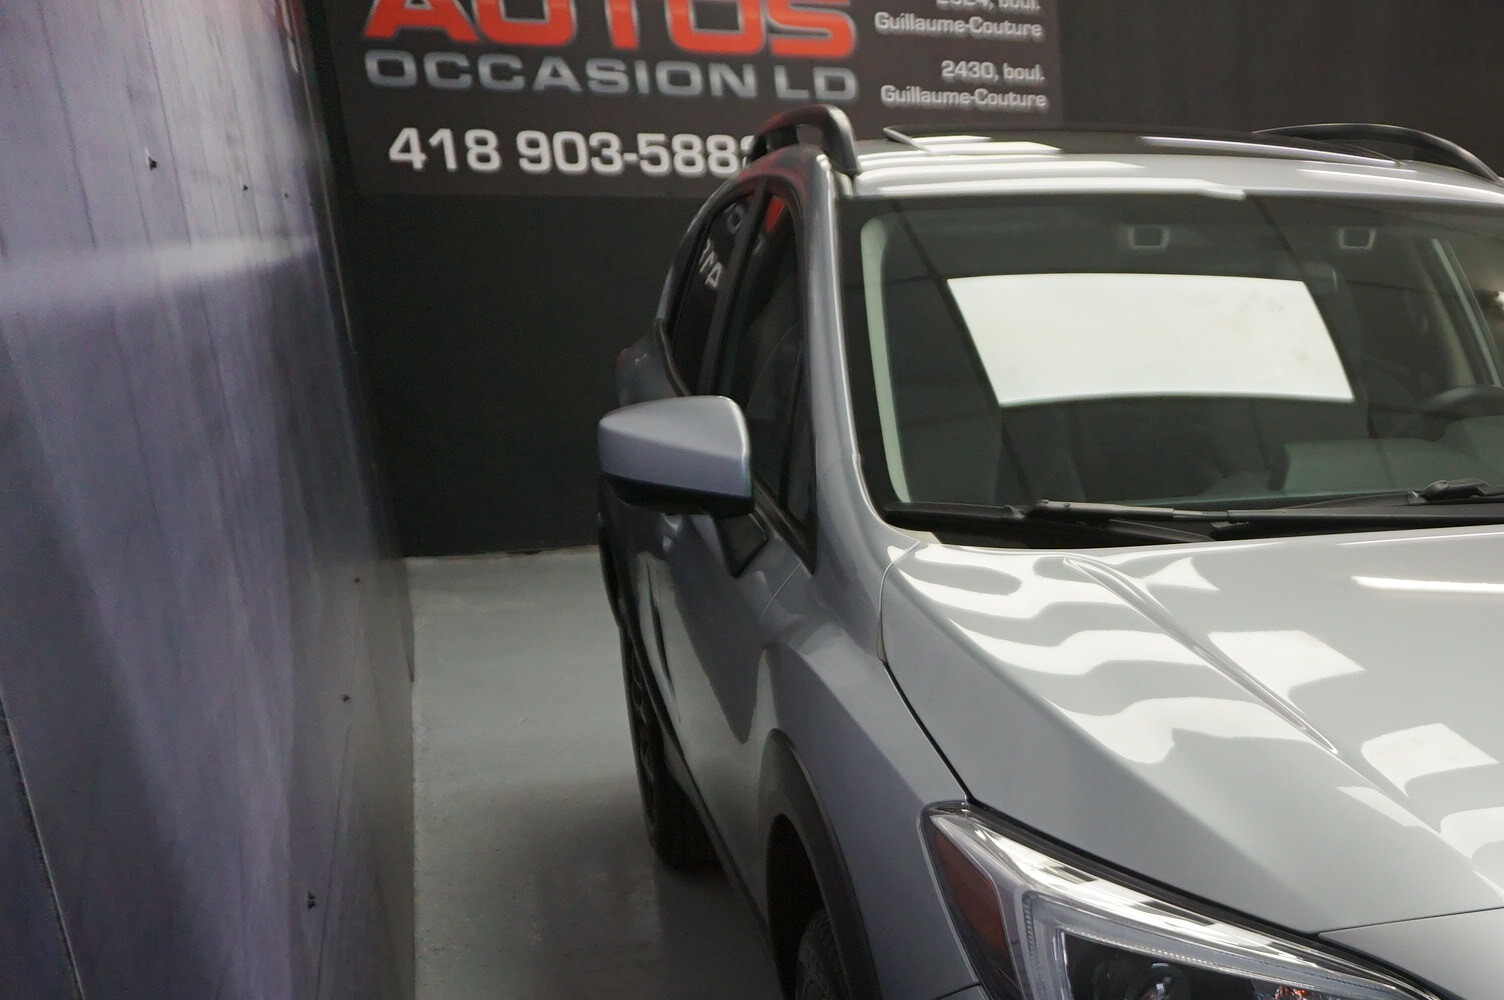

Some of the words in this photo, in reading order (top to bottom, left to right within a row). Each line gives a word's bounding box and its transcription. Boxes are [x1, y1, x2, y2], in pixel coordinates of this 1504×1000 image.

[873, 11, 1045, 38] Guillaume-Couture
[364, 50, 758, 98] OCCASION
[774, 64, 859, 101] LD
[941, 60, 999, 82] 2430,
[1003, 62, 1046, 82] boul.
[880, 84, 1049, 109] Guillaume-Couture
[388, 127, 502, 174] 418
[516, 130, 756, 178] 903-588
